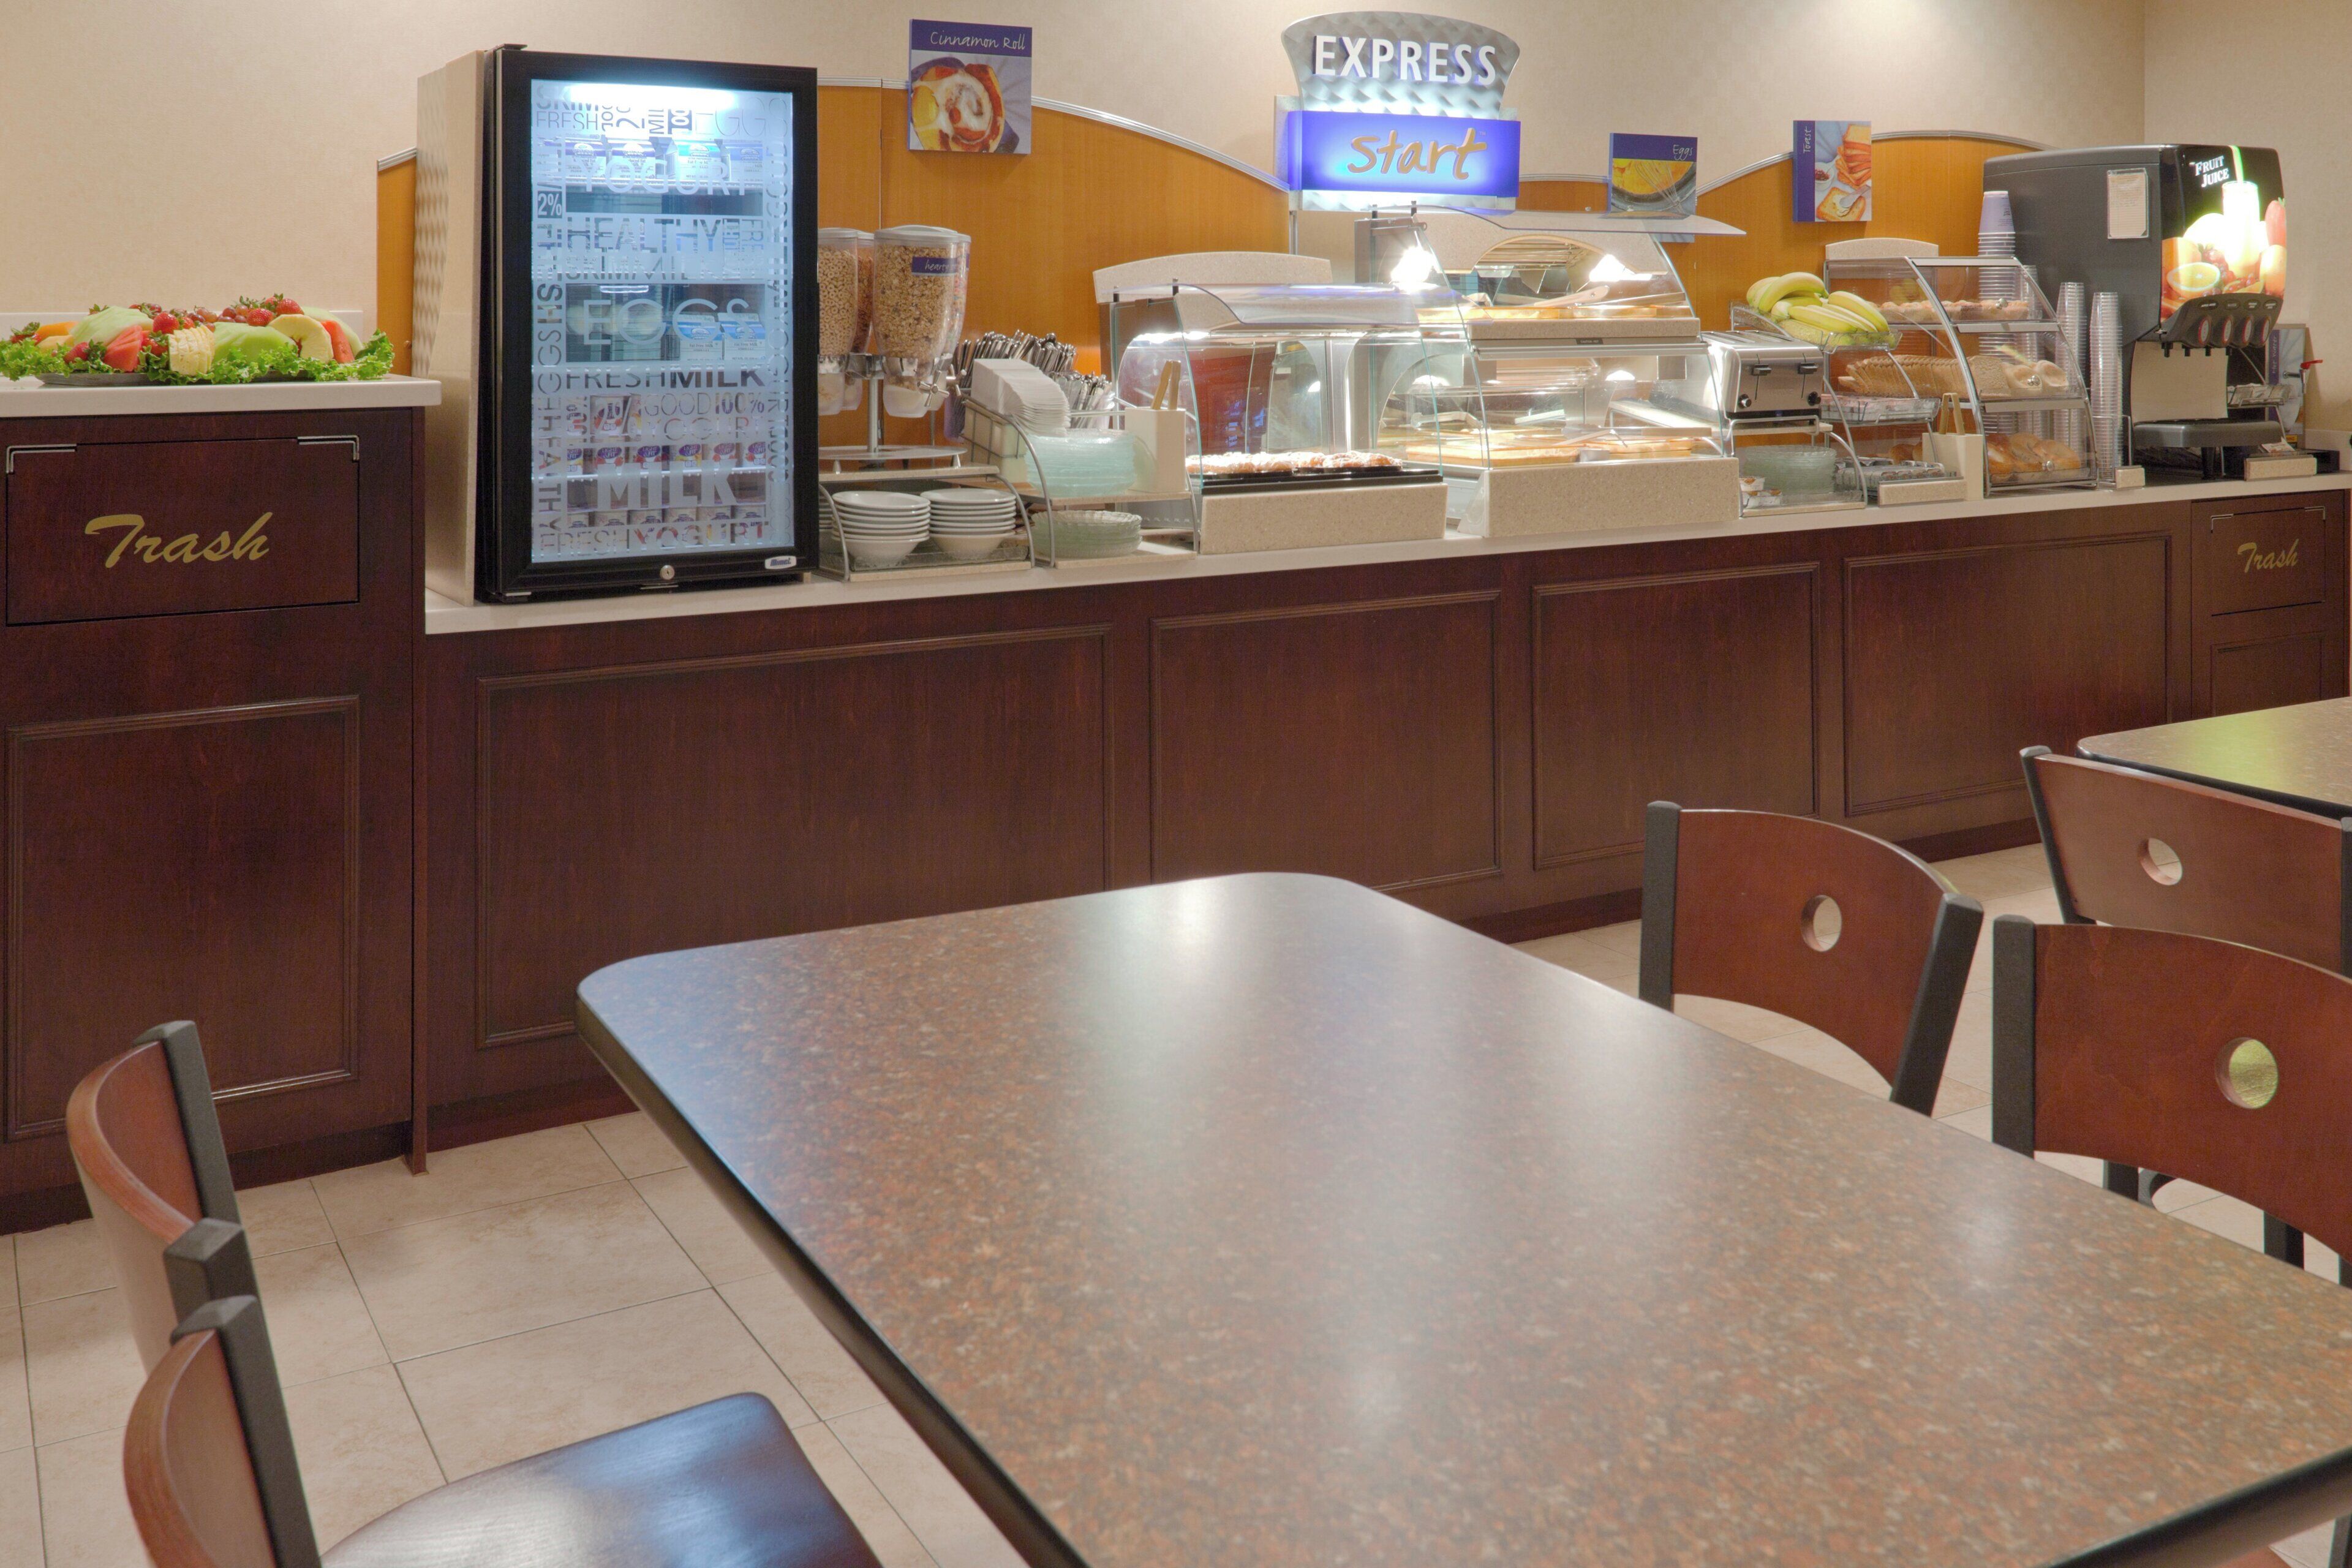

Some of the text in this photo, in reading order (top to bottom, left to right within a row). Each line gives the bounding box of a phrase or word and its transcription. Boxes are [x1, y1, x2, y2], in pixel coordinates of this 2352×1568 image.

[930, 30, 1026, 50] Cinnamon Roll
[1313, 35, 1496, 86] EXPRESS
[1672, 145, 1693, 161] Eggs
[1803, 126, 1812, 154] Toast
[576, 159, 753, 196] YOGURT
[2195, 155, 2224, 176] FRUIT
[2201, 167, 2230, 188] JUICE
[537, 192, 562, 217] 2%
[567, 217, 722, 254] HEALTHY
[583, 298, 751, 345] EGGS
[670, 365, 765, 390] MILK
[644, 391, 765, 417] GOOD 100%
[597, 459, 737, 510] MILK
[85, 511, 273, 570] Trash
[633, 521, 769, 552] YOGURT
[2237, 538, 2300, 573] Trash
